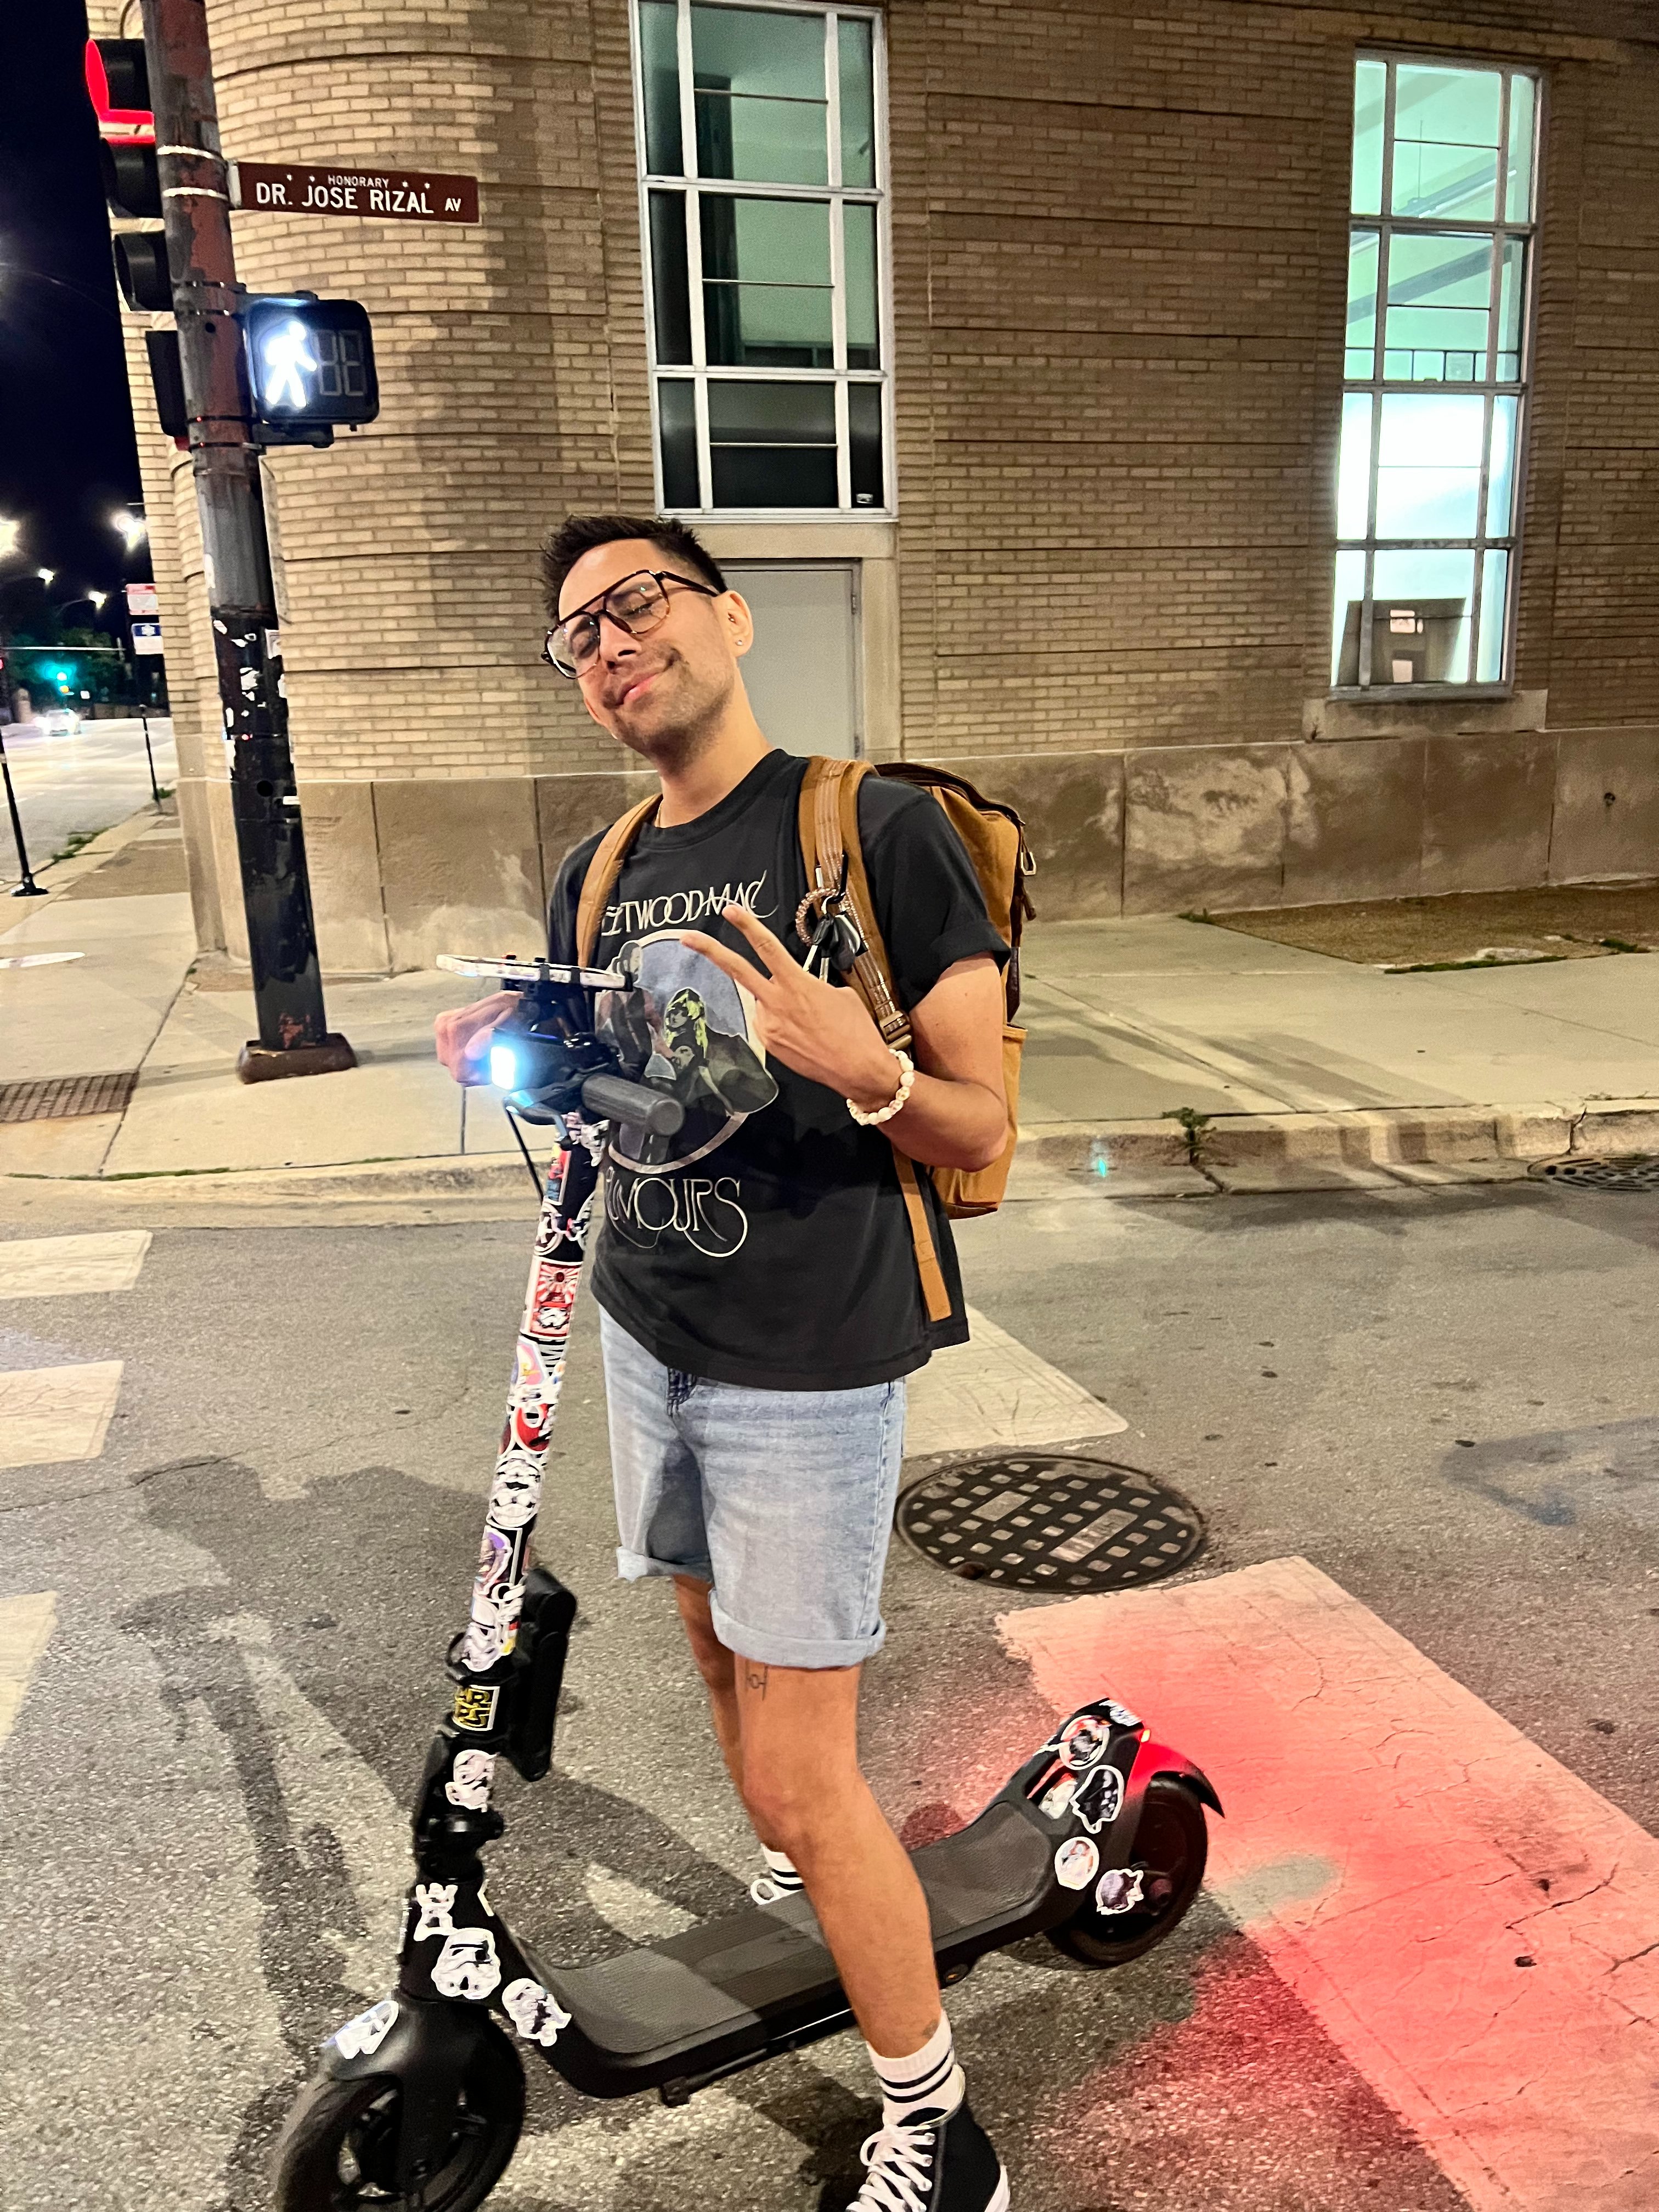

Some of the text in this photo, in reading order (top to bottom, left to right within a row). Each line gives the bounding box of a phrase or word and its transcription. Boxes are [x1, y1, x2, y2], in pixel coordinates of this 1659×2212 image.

[328, 174, 389, 188] HONORARY
[256, 182, 461, 213] DR. JOSE RIZAL AV
